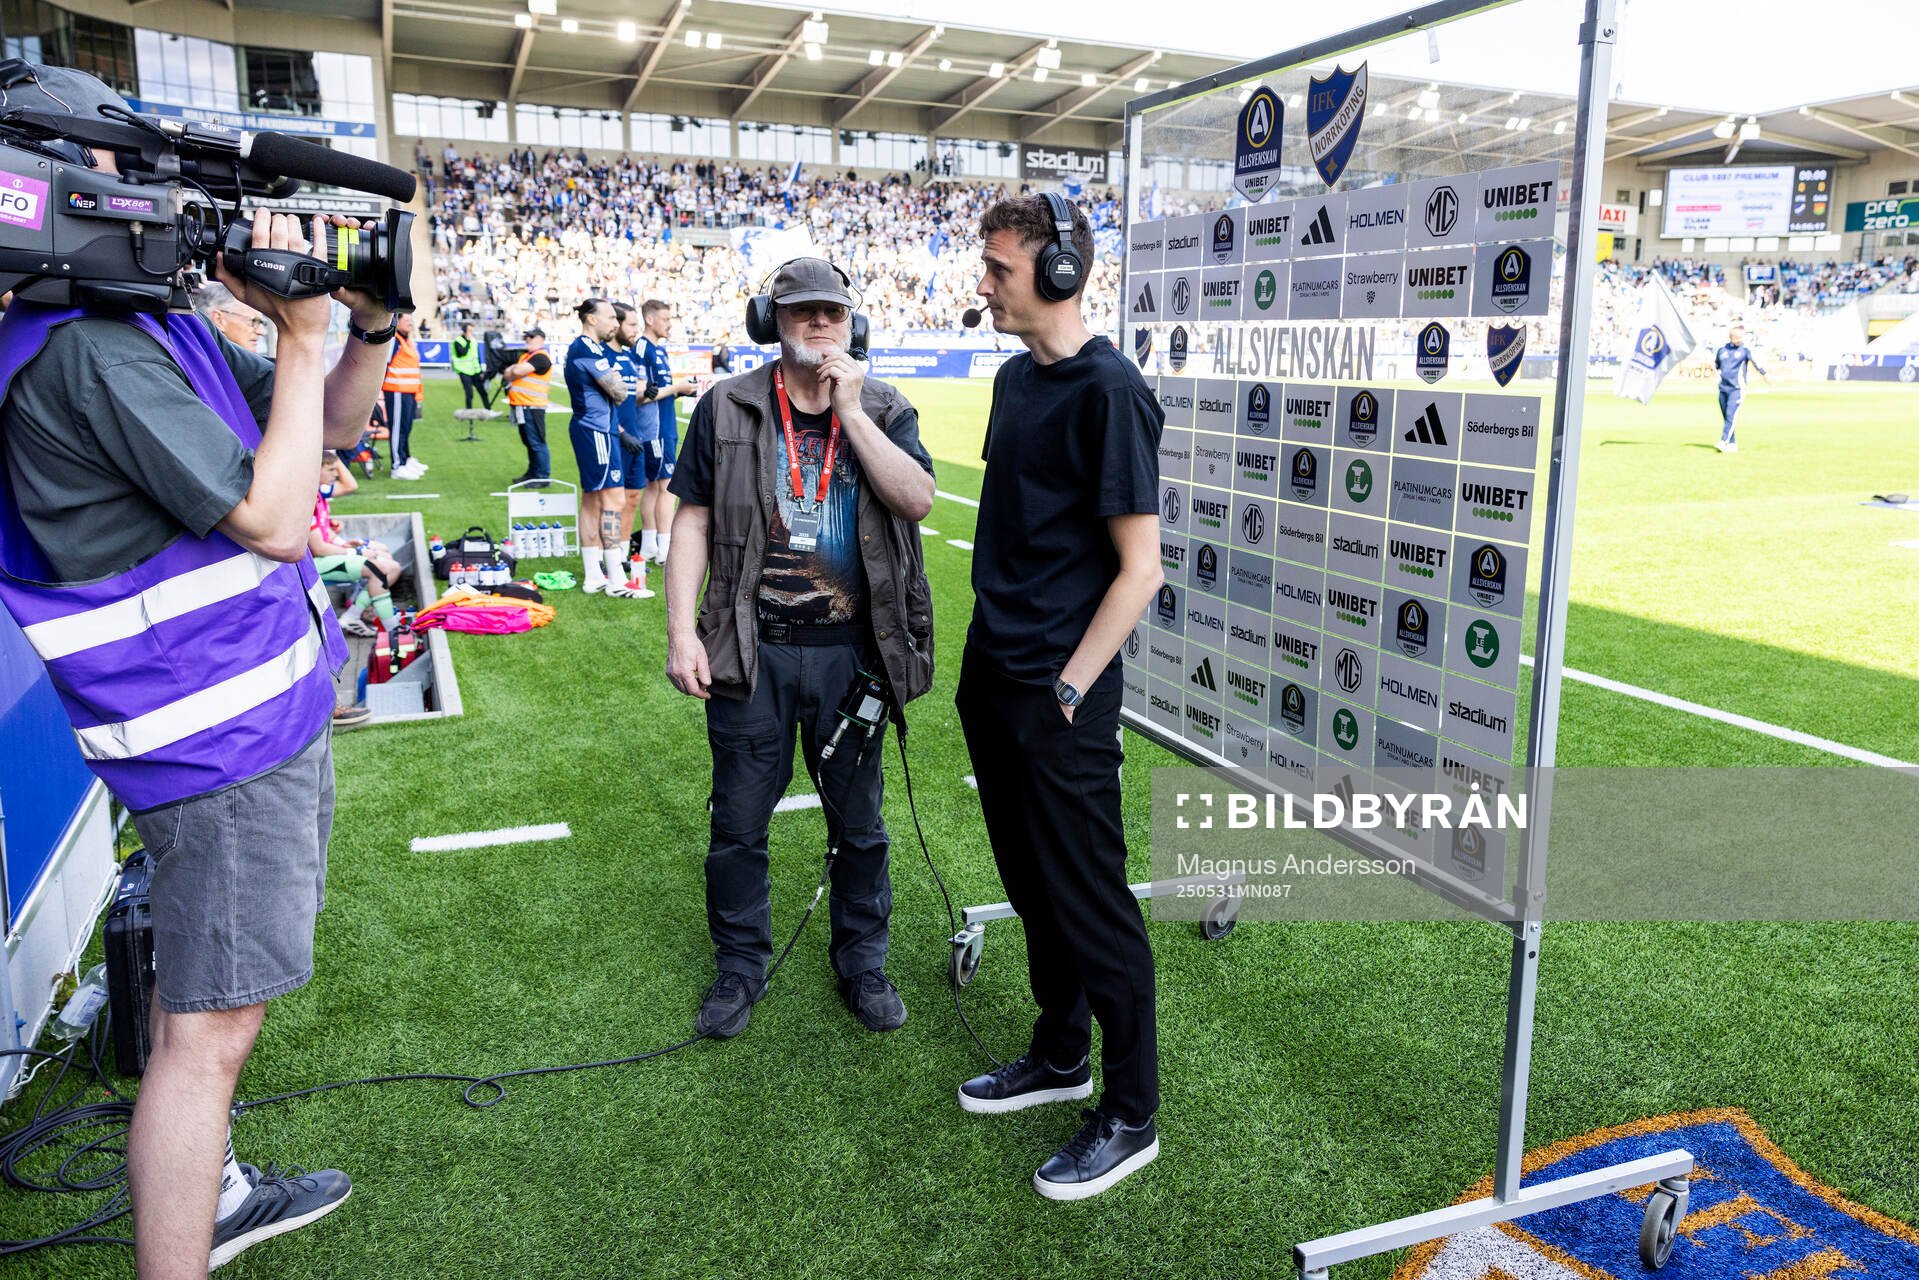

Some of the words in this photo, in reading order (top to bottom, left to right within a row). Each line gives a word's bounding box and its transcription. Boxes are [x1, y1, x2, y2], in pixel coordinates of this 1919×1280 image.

[1312, 89, 1337, 113] IFK
[1315, 86, 1364, 155] NORRKÖPING
[1025, 149, 1105, 173] stadium
[1239, 149, 1279, 170] ALLSVENSKAN
[1245, 175, 1269, 189] UNIBET
[76, 199, 96, 209] NEP
[1484, 181, 1553, 209] UNIBET
[1350, 208, 1405, 229] HOLMEN
[1427, 188, 1457, 235] MG
[1599, 205, 1626, 222] AXI
[1864, 200, 1899, 217] pre
[1249, 215, 1290, 236] UNIBET
[1863, 214, 1910, 230] zero
[1131, 241, 1156, 252] Söderbergs
[1168, 234, 1199, 251] stadium
[253, 260, 286, 271] Canon
[1292, 279, 1339, 292] PLATINUMCARS
[1347, 270, 1398, 286] Strawberry
[1408, 266, 1468, 287] UNIBET
[1173, 278, 1190, 312] MG
[1203, 280, 1240, 297] UNIBET
[1495, 282, 1527, 293] ALLSVENSKAN
[1500, 297, 1520, 305] UNIBET
[1212, 327, 1376, 381] ALLSVENSKAN
[1492, 337, 1525, 369] NORRKÖPING
[1160, 395, 1193, 409] HOLMEN
[1200, 398, 1232, 414] stadium
[1286, 398, 1332, 418] UNIBET
[1467, 421, 1520, 439] Söderbergs
[1521, 425, 1534, 437] Bil
[1158, 447, 1183, 460] Söderbergs
[1195, 445, 1231, 463] Strawberry
[1236, 451, 1277, 471] UNIBET
[1394, 480, 1452, 500] PLATINUMCARS
[1462, 482, 1529, 510] UNIBET
[1164, 489, 1179, 521] MG
[1193, 498, 1228, 520] UNIBET
[1244, 506, 1263, 541] MG
[1279, 525, 1315, 543] Söderbergs
[1315, 533, 1324, 543] Bil
[1160, 542, 1186, 562] NIBET
[1333, 536, 1379, 559] stadium
[1390, 539, 1447, 568] UNIBET
[1231, 566, 1272, 586] PLATINUMCARS
[1276, 582, 1321, 607] HOLMEN
[1328, 588, 1378, 617] UNIBET
[1188, 608, 1224, 632] HOLMEN
[1230, 625, 1266, 649] stadium
[1274, 632, 1318, 661] UNIBET
[1150, 645, 1176, 664] Söderbergs
[1337, 651, 1360, 690] MG
[1227, 670, 1266, 699] UNIBET
[1380, 676, 1438, 708] HOLMEN
[1150, 694, 1180, 718] stadium
[1186, 703, 1221, 732] UNIBET
[1448, 702, 1507, 734] stadium
[1225, 721, 1264, 752] Strawberry
[1378, 738, 1434, 768] PLATINUMCARS
[1270, 750, 1315, 782] HOLMEN
[1443, 757, 1505, 796] UNIBET
